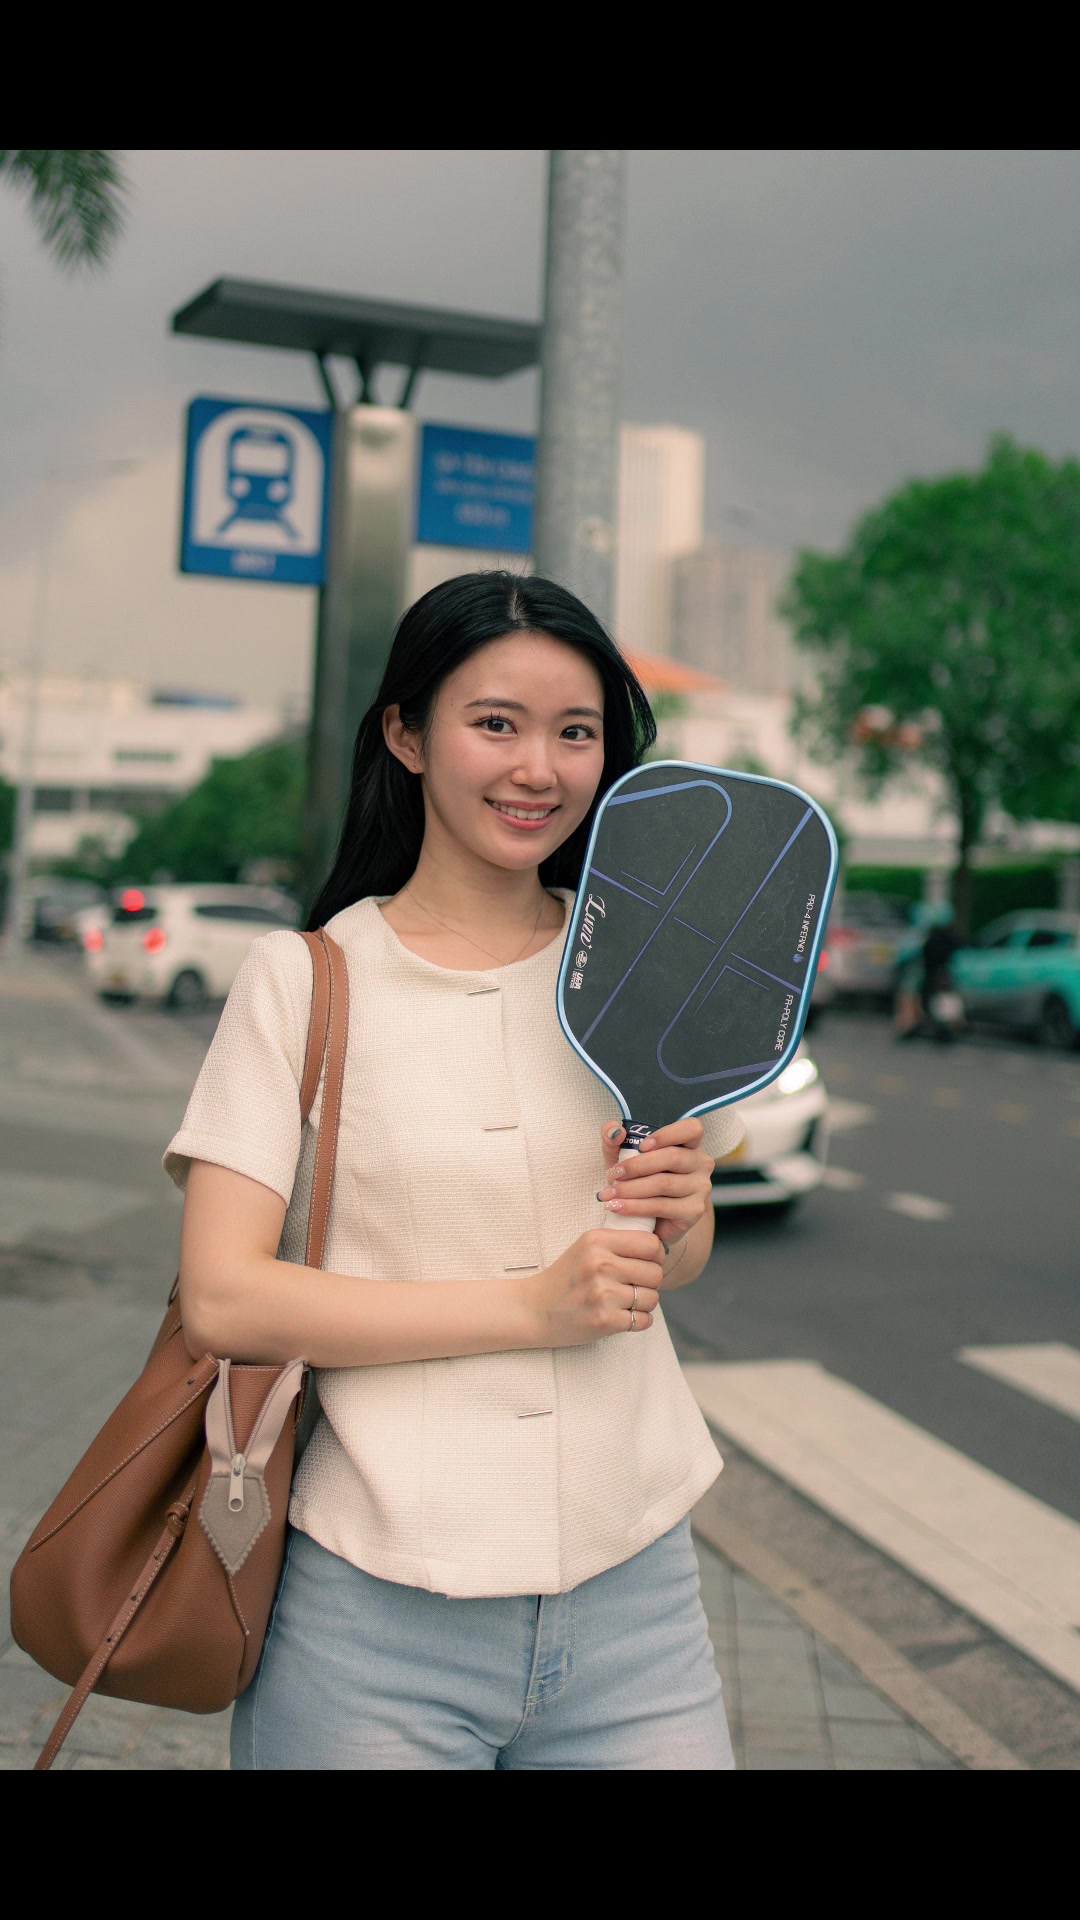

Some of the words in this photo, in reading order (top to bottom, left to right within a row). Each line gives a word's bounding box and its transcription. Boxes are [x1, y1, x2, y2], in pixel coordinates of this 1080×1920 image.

[804, 893, 816, 920] PRO-4
[797, 920, 810, 953] INFERNO
[779, 994, 794, 1030] FR-POLY
[774, 1029, 787, 1052] CORE
